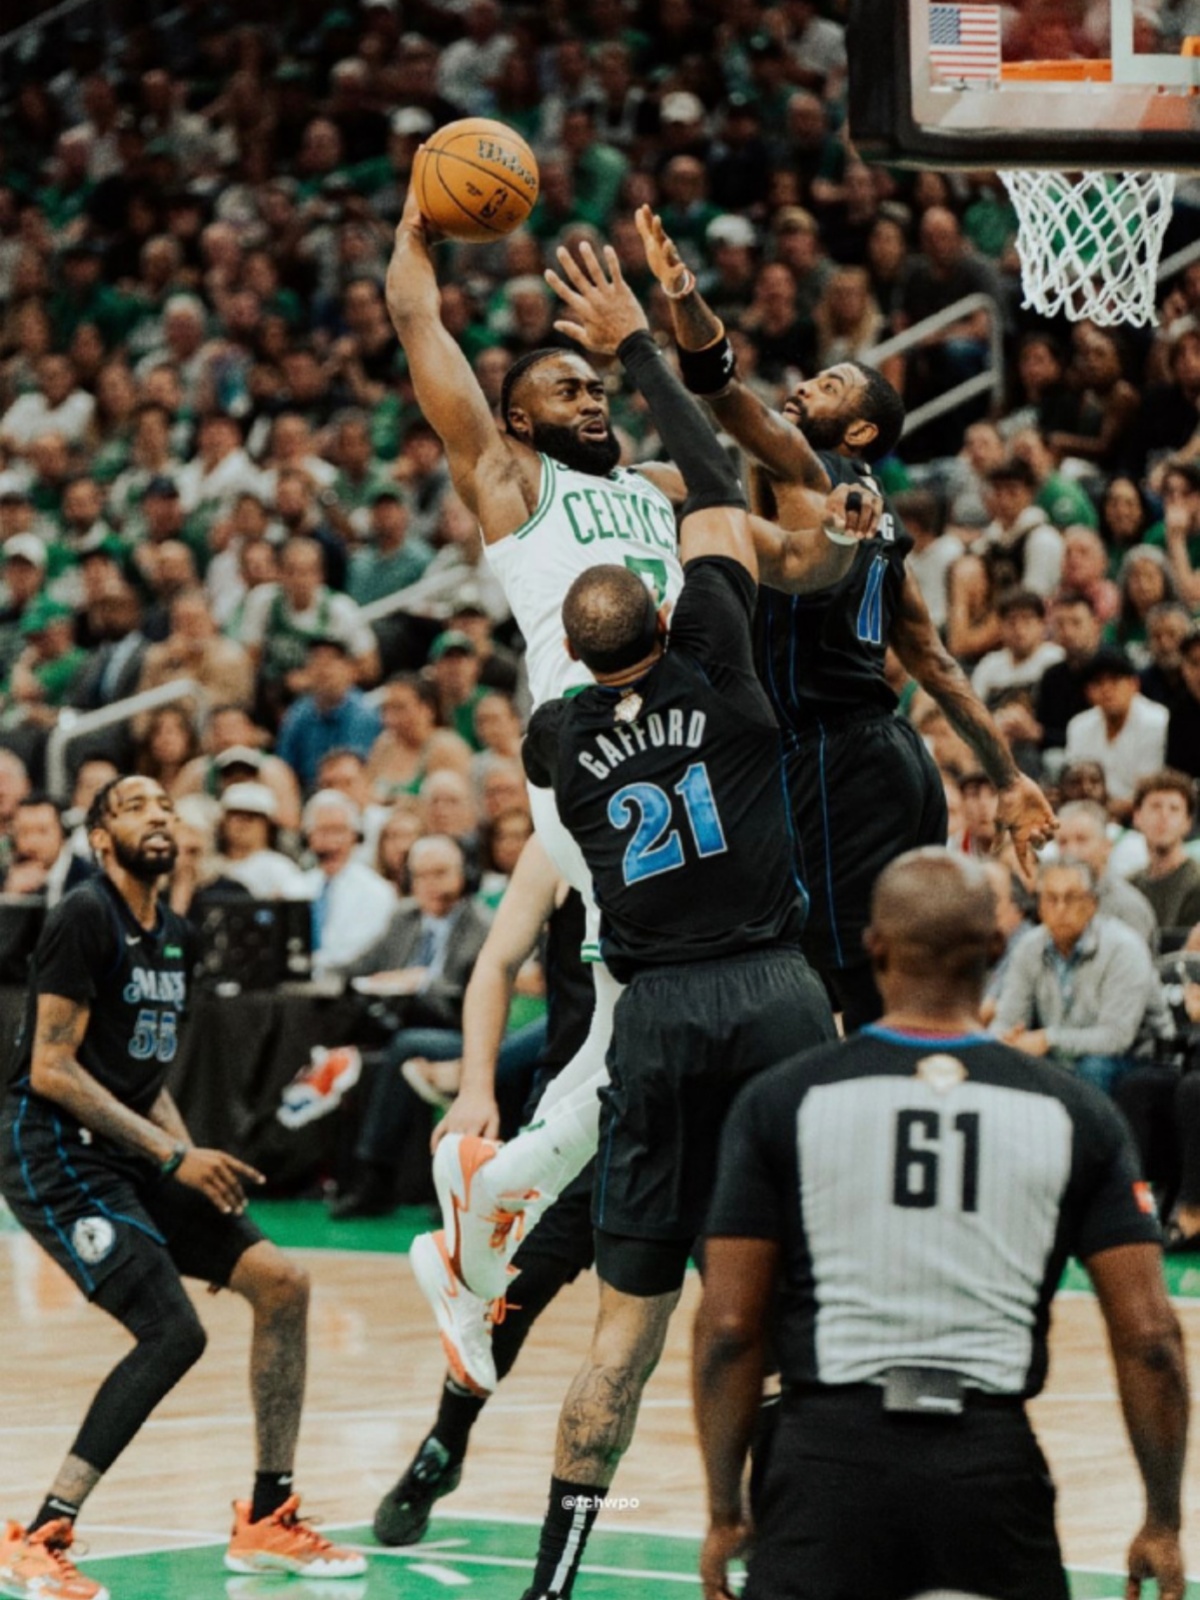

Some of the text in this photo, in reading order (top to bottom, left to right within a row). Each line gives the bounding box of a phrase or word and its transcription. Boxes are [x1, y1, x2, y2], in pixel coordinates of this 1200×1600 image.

[578, 708, 707, 780] GAFFORD
[607, 762, 728, 886] 21
[128, 1009, 178, 1063] 55
[892, 1108, 980, 1213] 61
